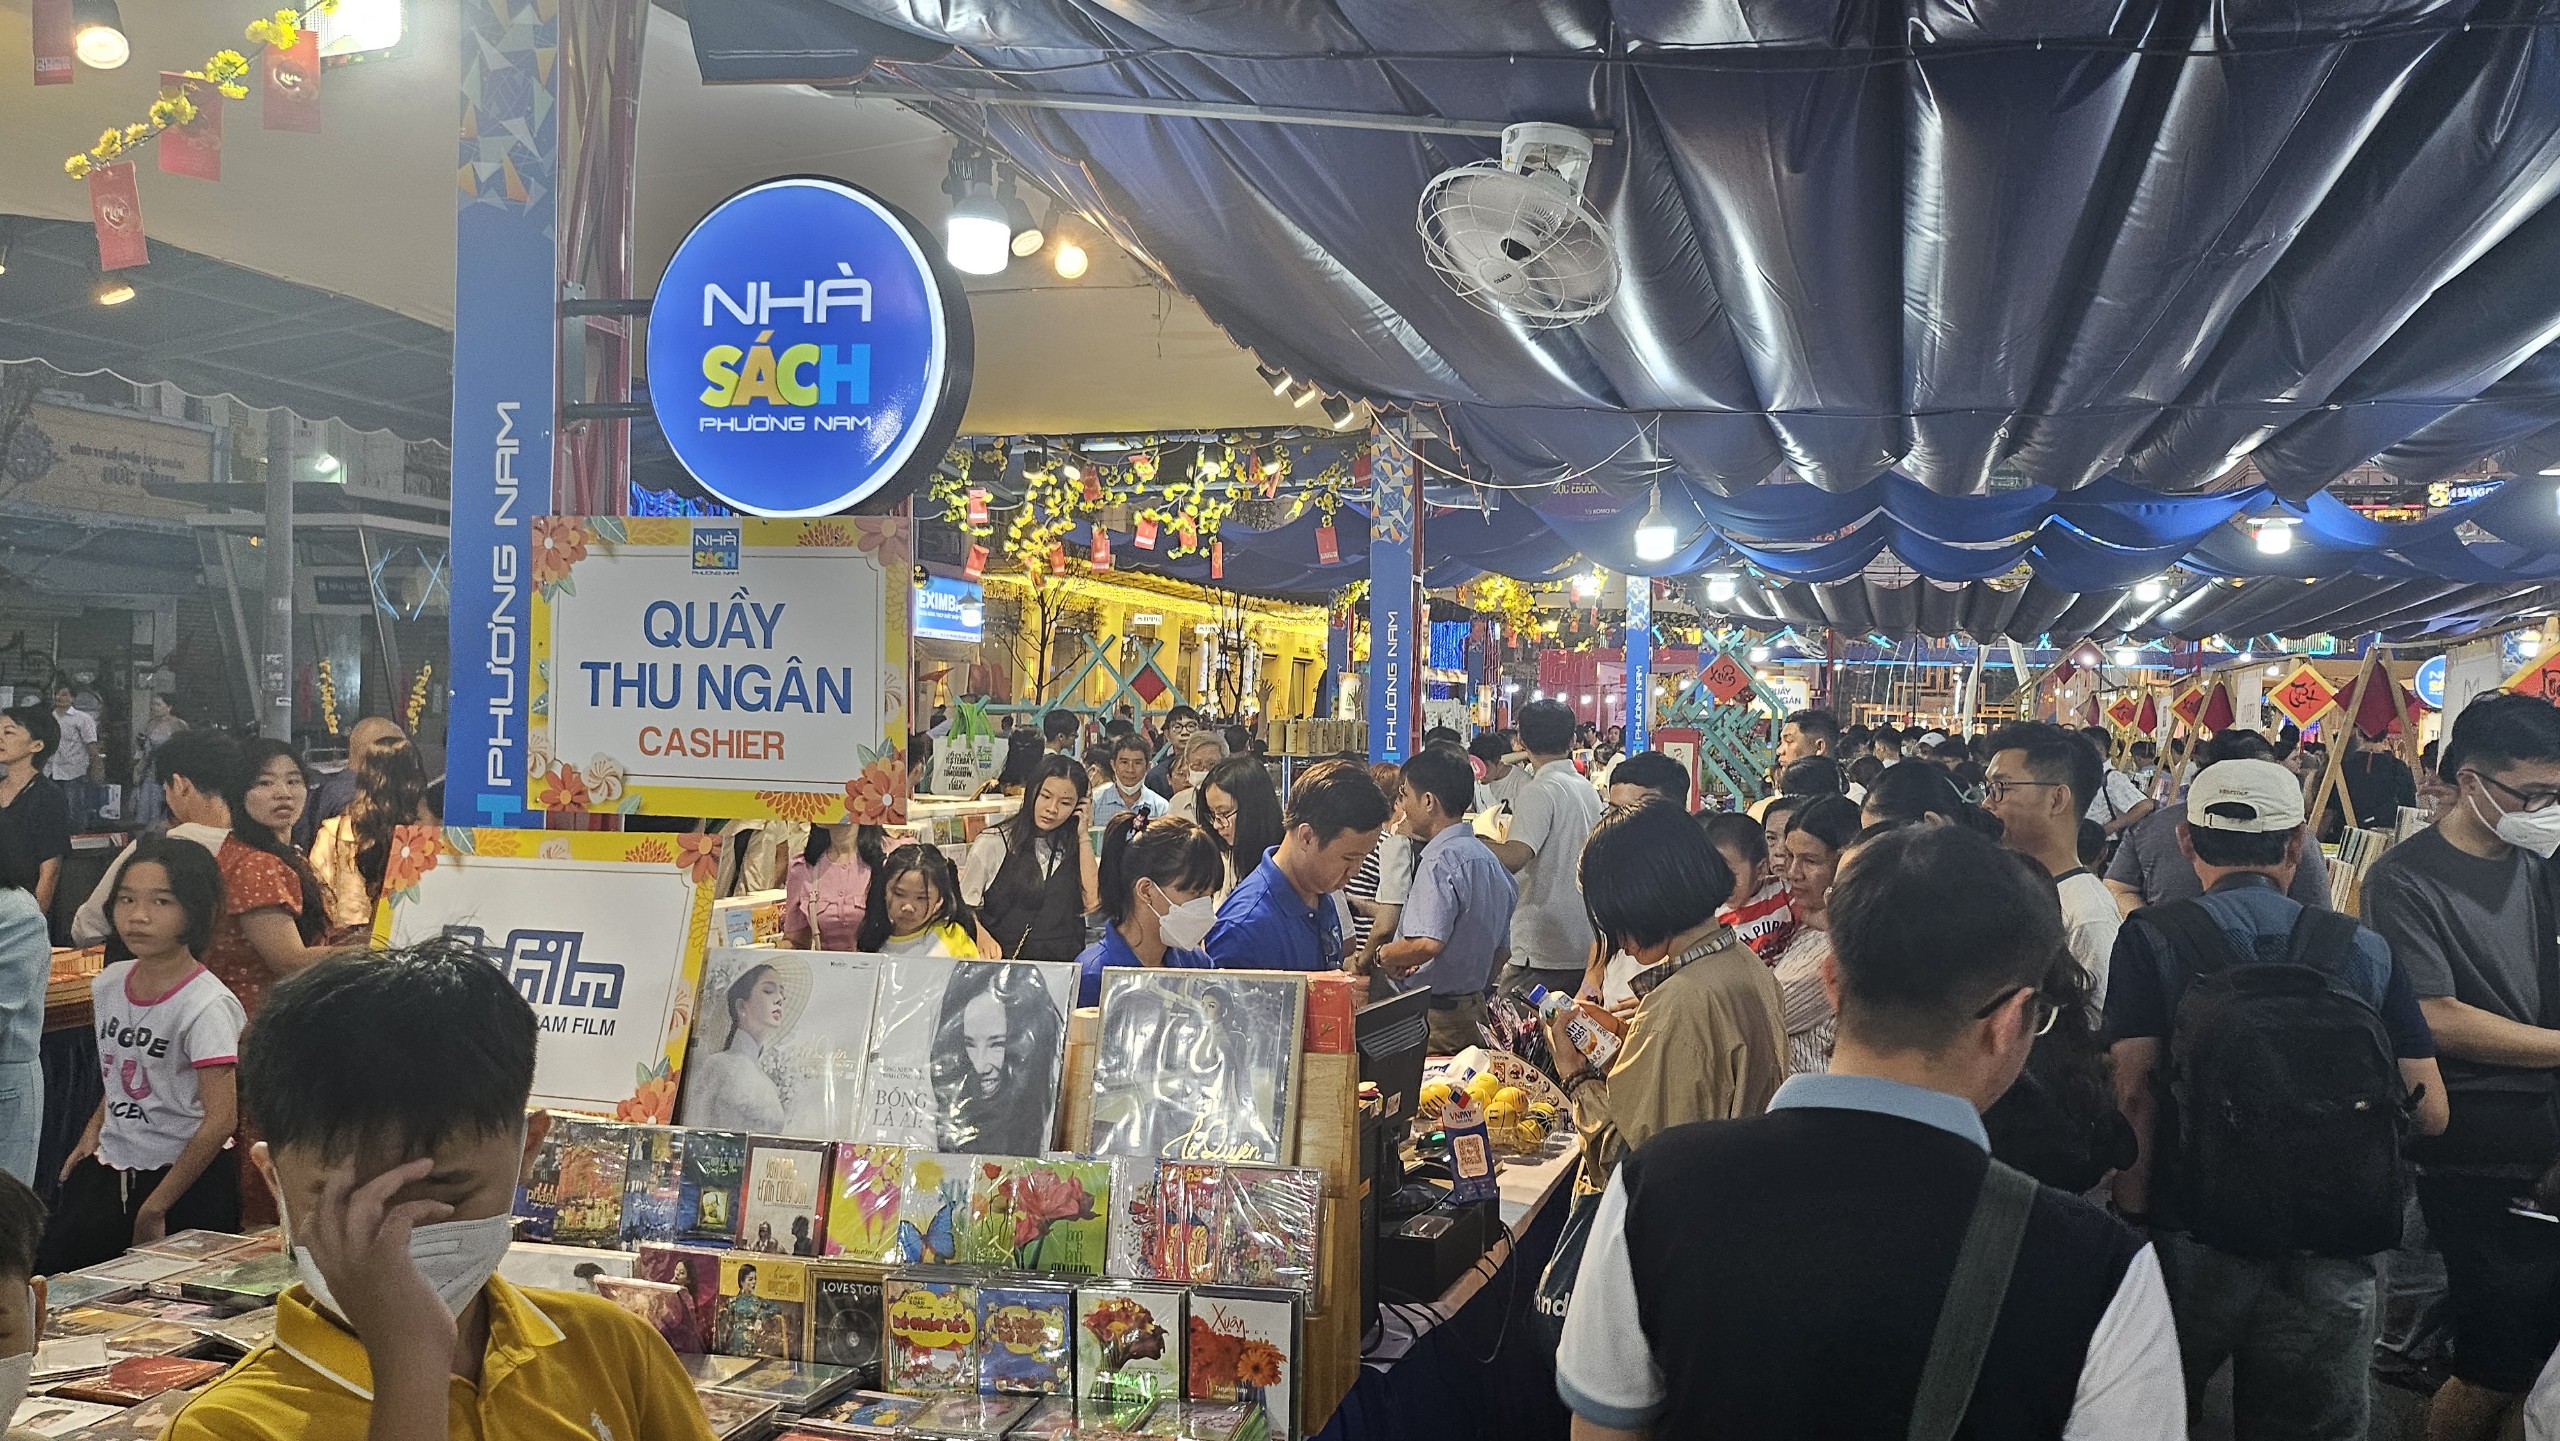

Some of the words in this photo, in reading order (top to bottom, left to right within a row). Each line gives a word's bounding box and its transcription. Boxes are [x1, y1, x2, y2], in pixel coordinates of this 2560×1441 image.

[703, 262, 872, 326] NHÀ
[700, 329, 870, 408] SÁCH
[700, 414, 805, 432] PHƯƠNG
[814, 415, 872, 431] NAM
[494, 402, 521, 526] NAM
[694, 547, 737, 567] SÁCH
[695, 530, 737, 546] NHÀ
[643, 585, 786, 650] QUẦY
[1387, 611, 1399, 657] NAM
[487, 545, 517, 787] PHƯƠNG
[579, 661, 682, 710] THU
[697, 655, 852, 715] NGÂN
[1385, 662, 1398, 751] PHƯƠNG
[638, 725, 786, 761] CASHIER
[538, 1015, 569, 1034] AM
[571, 1017, 616, 1037] FILM
[1571, 1024, 1588, 1044] oost
[872, 1106, 895, 1127] LÀ
[1211, 1302, 1247, 1340] Xuân
